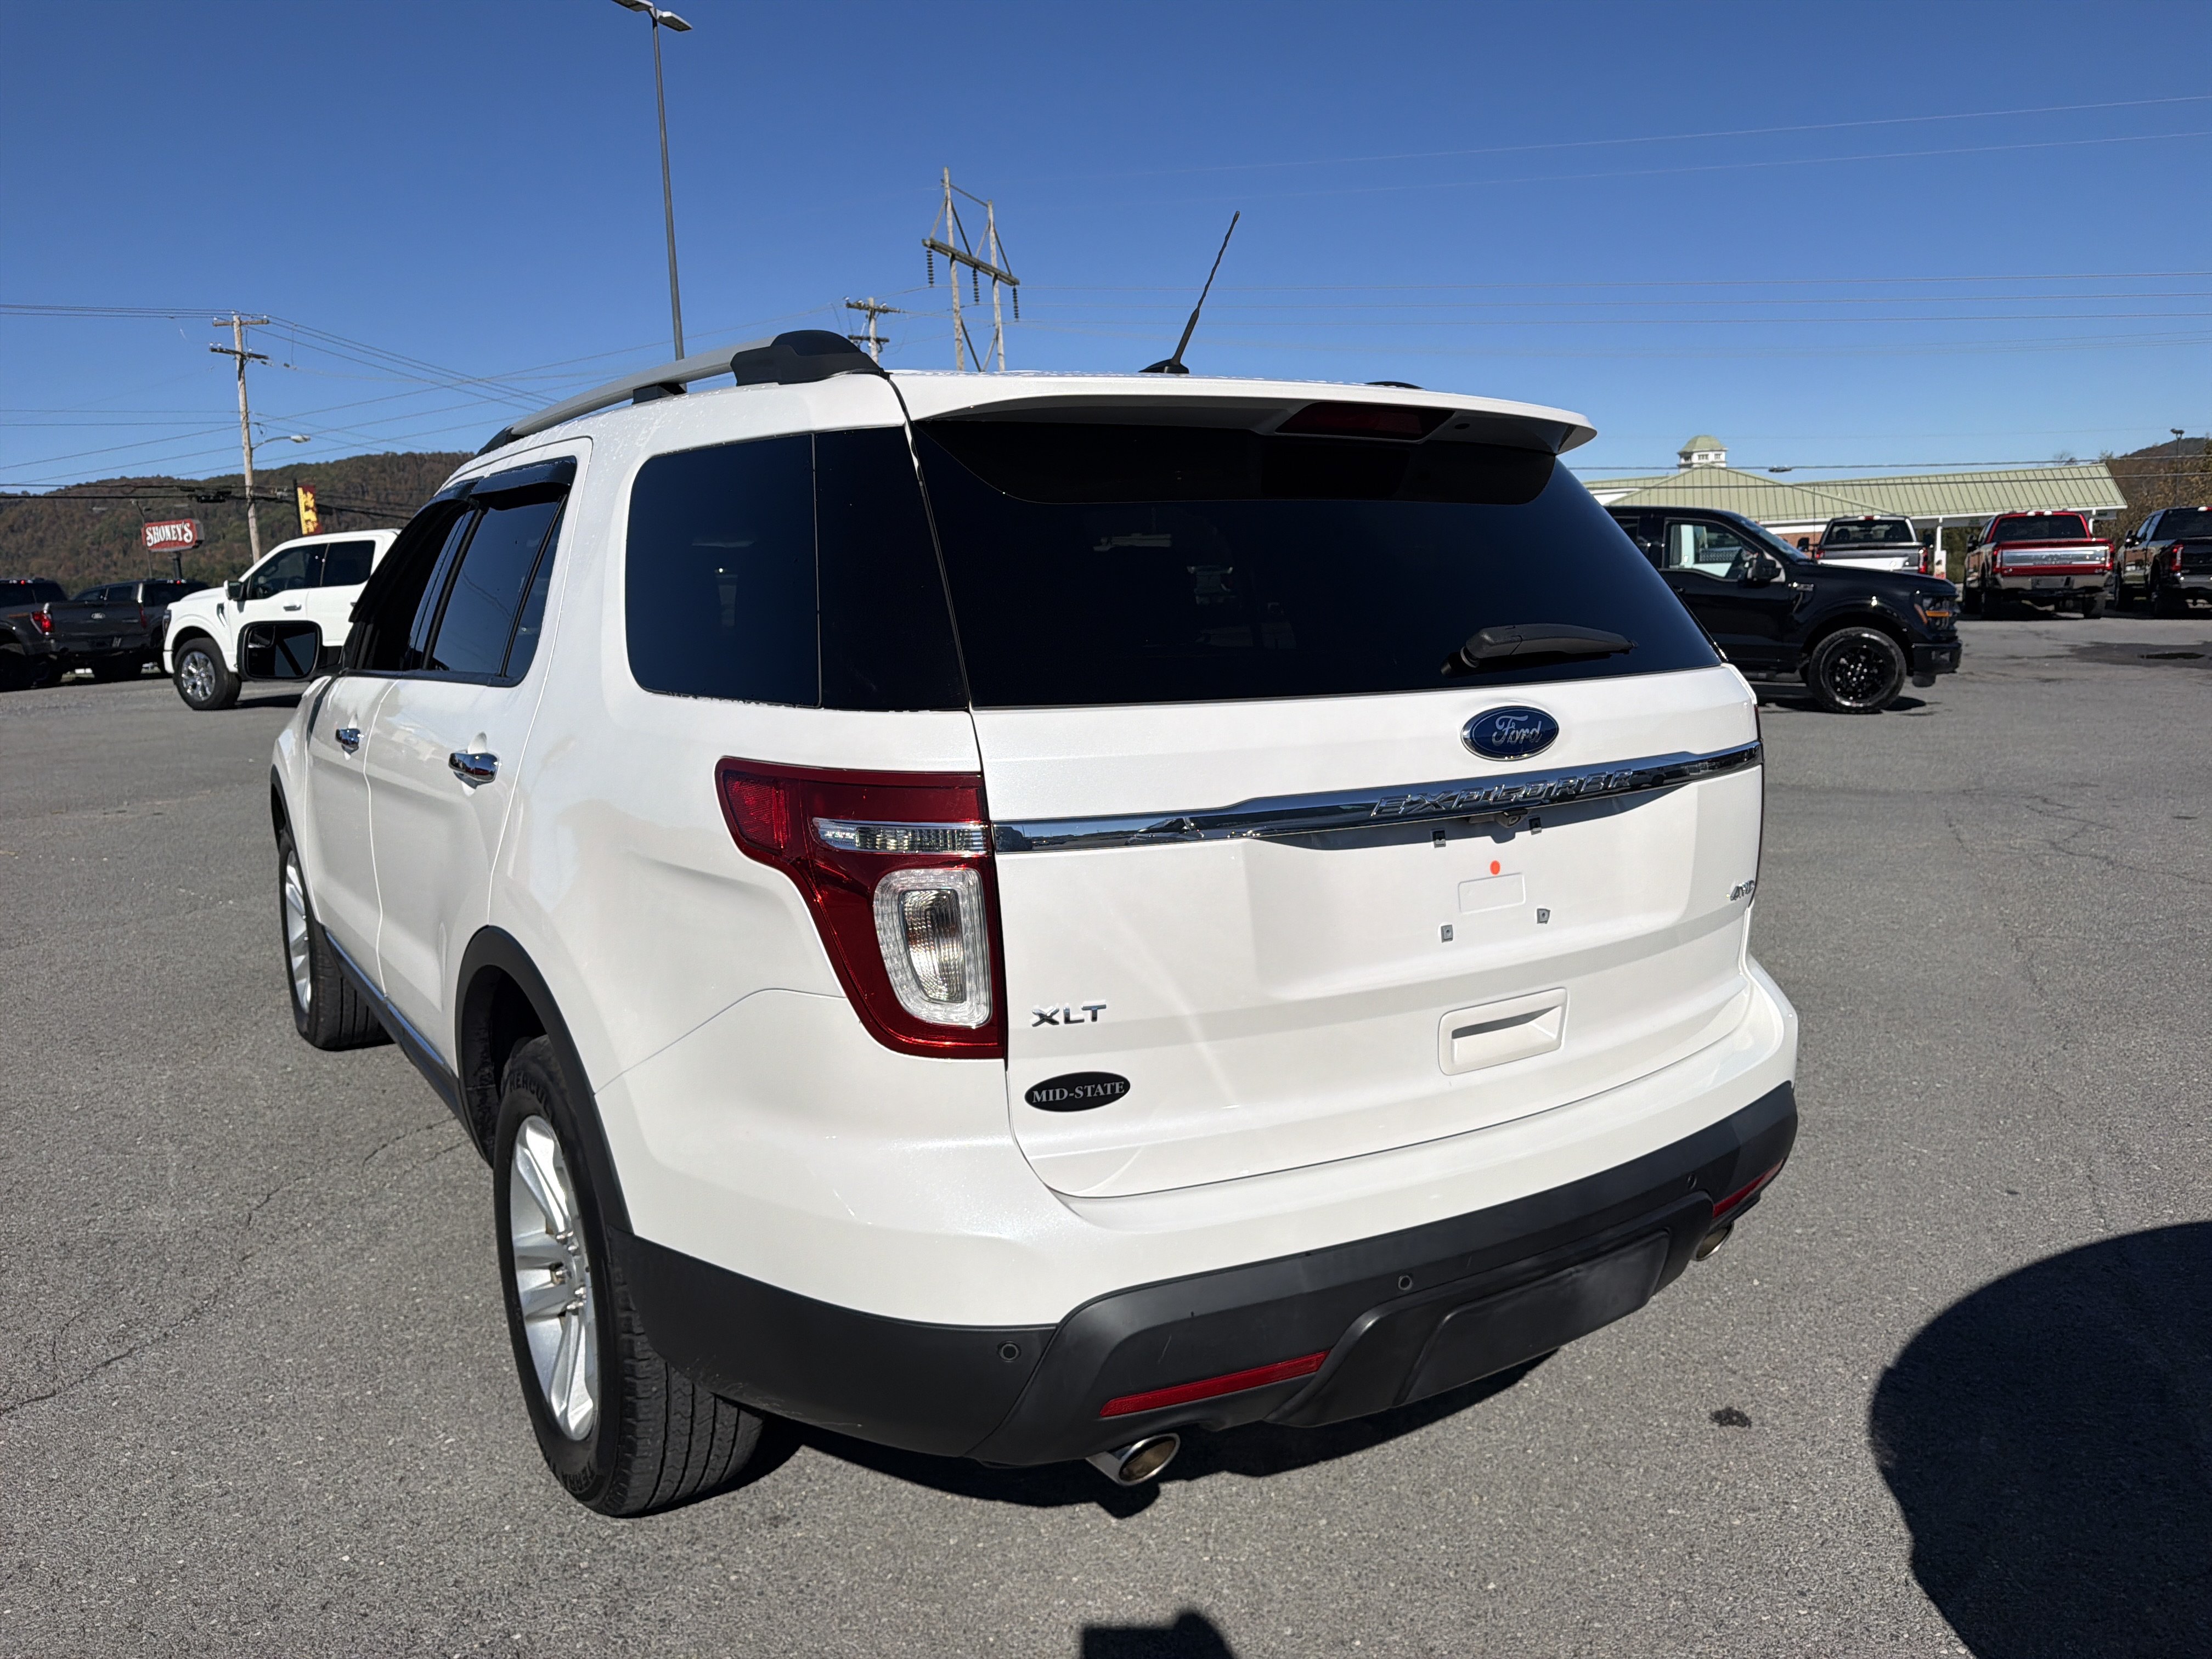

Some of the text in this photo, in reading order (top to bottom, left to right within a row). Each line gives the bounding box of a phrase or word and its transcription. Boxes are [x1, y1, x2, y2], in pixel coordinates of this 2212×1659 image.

[146, 521, 193, 547] SHONEY'S
[1492, 715, 1542, 746] Ford
[1370, 769, 1633, 817] EXPLORER
[1031, 1004, 1107, 1027] XLT
[1032, 1081, 1125, 1103] MID-STATE
